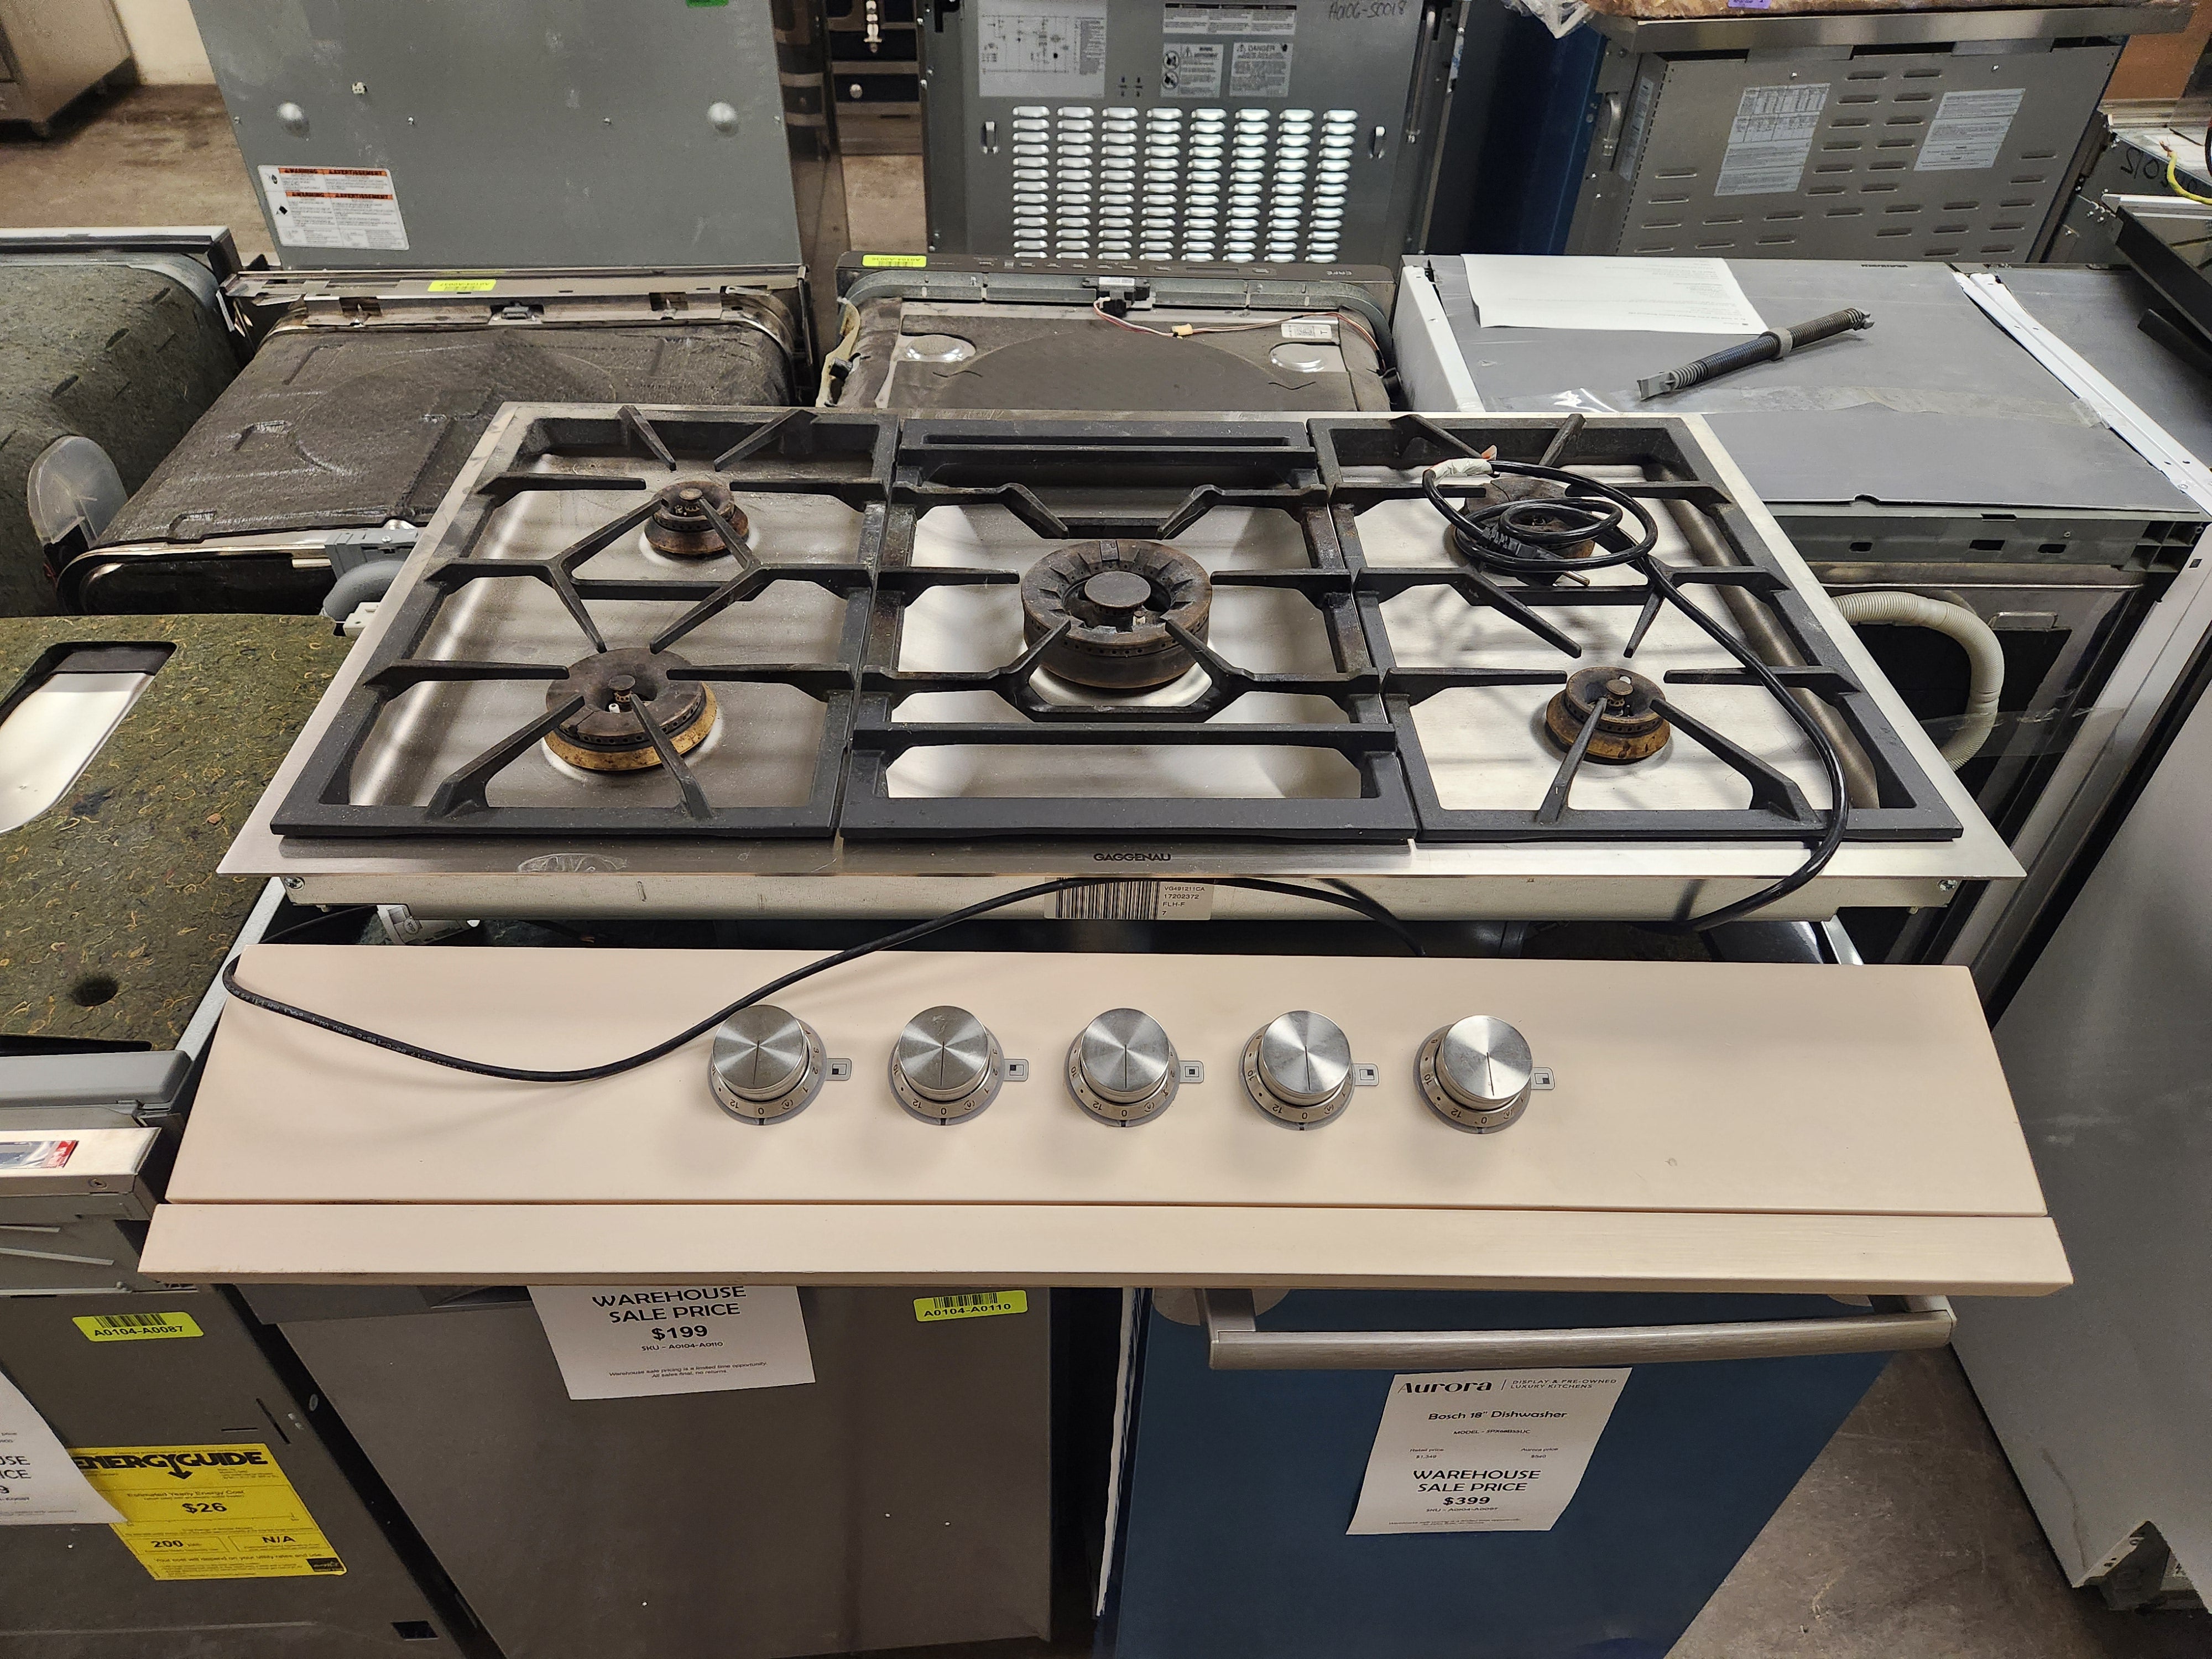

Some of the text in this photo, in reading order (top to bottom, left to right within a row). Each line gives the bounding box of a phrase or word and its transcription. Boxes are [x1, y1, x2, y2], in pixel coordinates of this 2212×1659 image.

[893, 1064, 899, 1076] 10
[912, 1098, 922, 1109] 12
[1071, 1066, 1077, 1078] 10
[1092, 1100, 1102, 1111] 12
[1247, 1070, 1254, 1082] 10
[1272, 1104, 1282, 1114] 12
[1301, 1112, 1308, 1120] 0
[1424, 1073, 1432, 1086] 10
[1451, 1108, 1462, 1118] 12
[729, 1098, 739, 1109] 12
[591, 1286, 747, 1307] WAREHOUSE
[608, 1303, 741, 1323] SALE PRICE
[924, 1303, 1011, 1317] A0104-A0110
[95, 1326, 183, 1337] A0104-A0087
[651, 1325, 708, 1341] $199
[1397, 1381, 1493, 1394] Aurora
[1428, 1412, 1466, 1421] Bosch
[1490, 1410, 1568, 1419] Dishwasher
[1413, 1470, 1542, 1479] WAREHOUSE
[1417, 1482, 1528, 1492] SALE PRICE
[1442, 1496, 1491, 1506] $399
[182, 1503, 228, 1514] $26
[150, 1540, 184, 1548] 200
[262, 1535, 296, 1544] N/A
